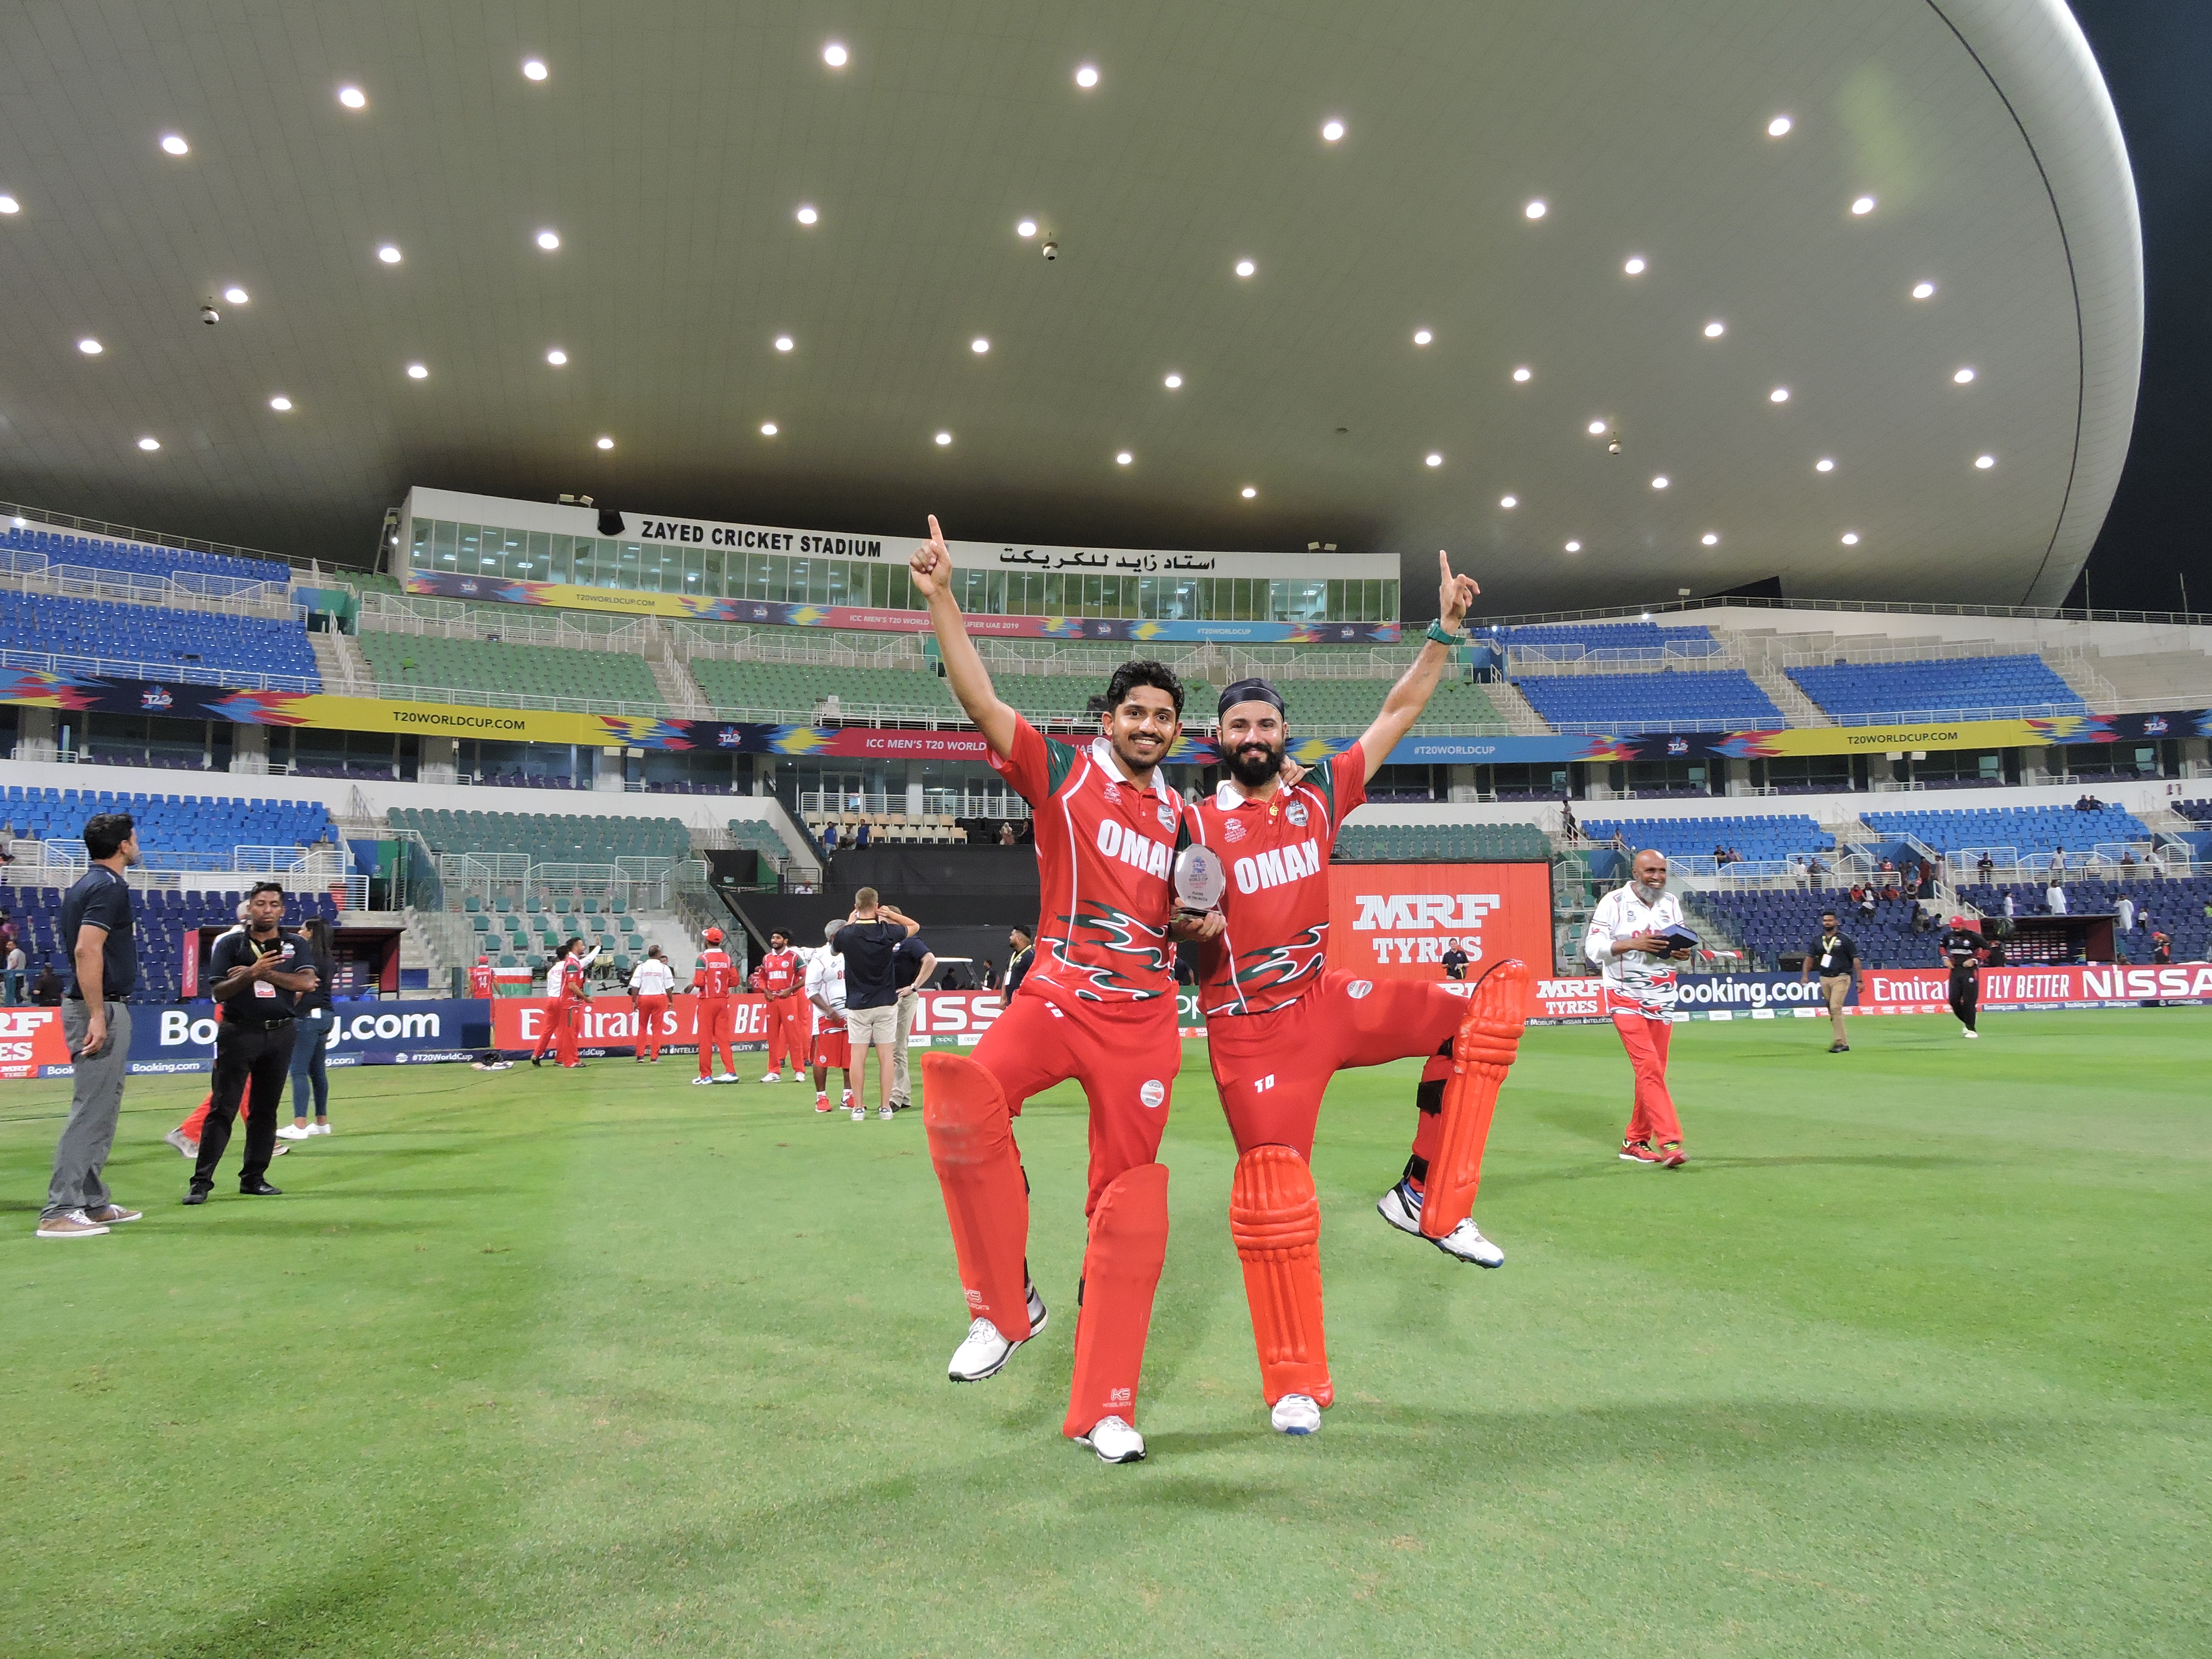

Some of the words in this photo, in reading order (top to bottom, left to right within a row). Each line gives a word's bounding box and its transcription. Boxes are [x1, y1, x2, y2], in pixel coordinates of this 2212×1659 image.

[641, 520, 704, 542] ZAYED
[712, 528, 794, 550] CRICKET
[800, 536, 881, 558] STADIUM
[1116, 553, 1157, 572] زايد
[1164, 555, 1215, 570] استاد
[576, 594, 655, 607] T20WORLDCUP.COM
[143, 694, 173, 705] T20
[393, 711, 525, 730] T20WORLDCUP.COM
[719, 733, 741, 743] T20
[866, 739, 884, 748] ICC
[926, 740, 945, 750] T20
[947, 741, 986, 751] WORLD
[1847, 732, 1958, 744] T20WORLDCUP.COM
[1414, 746, 1495, 755] #T20WORLDCUP
[1668, 743, 1688, 752] T20
[1234, 837, 1321, 894] OMAN
[1353, 894, 1500, 930] MRF
[715, 971, 721, 993] 5
[1536, 980, 1604, 998] MRF
[1986, 975, 2012, 999] FLY
[2016, 974, 2069, 998] BETTER
[1674, 976, 1824, 1008] ooking.com
[1545, 1000, 1598, 1014] TYRES
[412, 1053, 473, 1062] #T20WorldCup
[132, 1062, 200, 1073] Booking.com
[1111, 1388, 1130, 1401] KS
